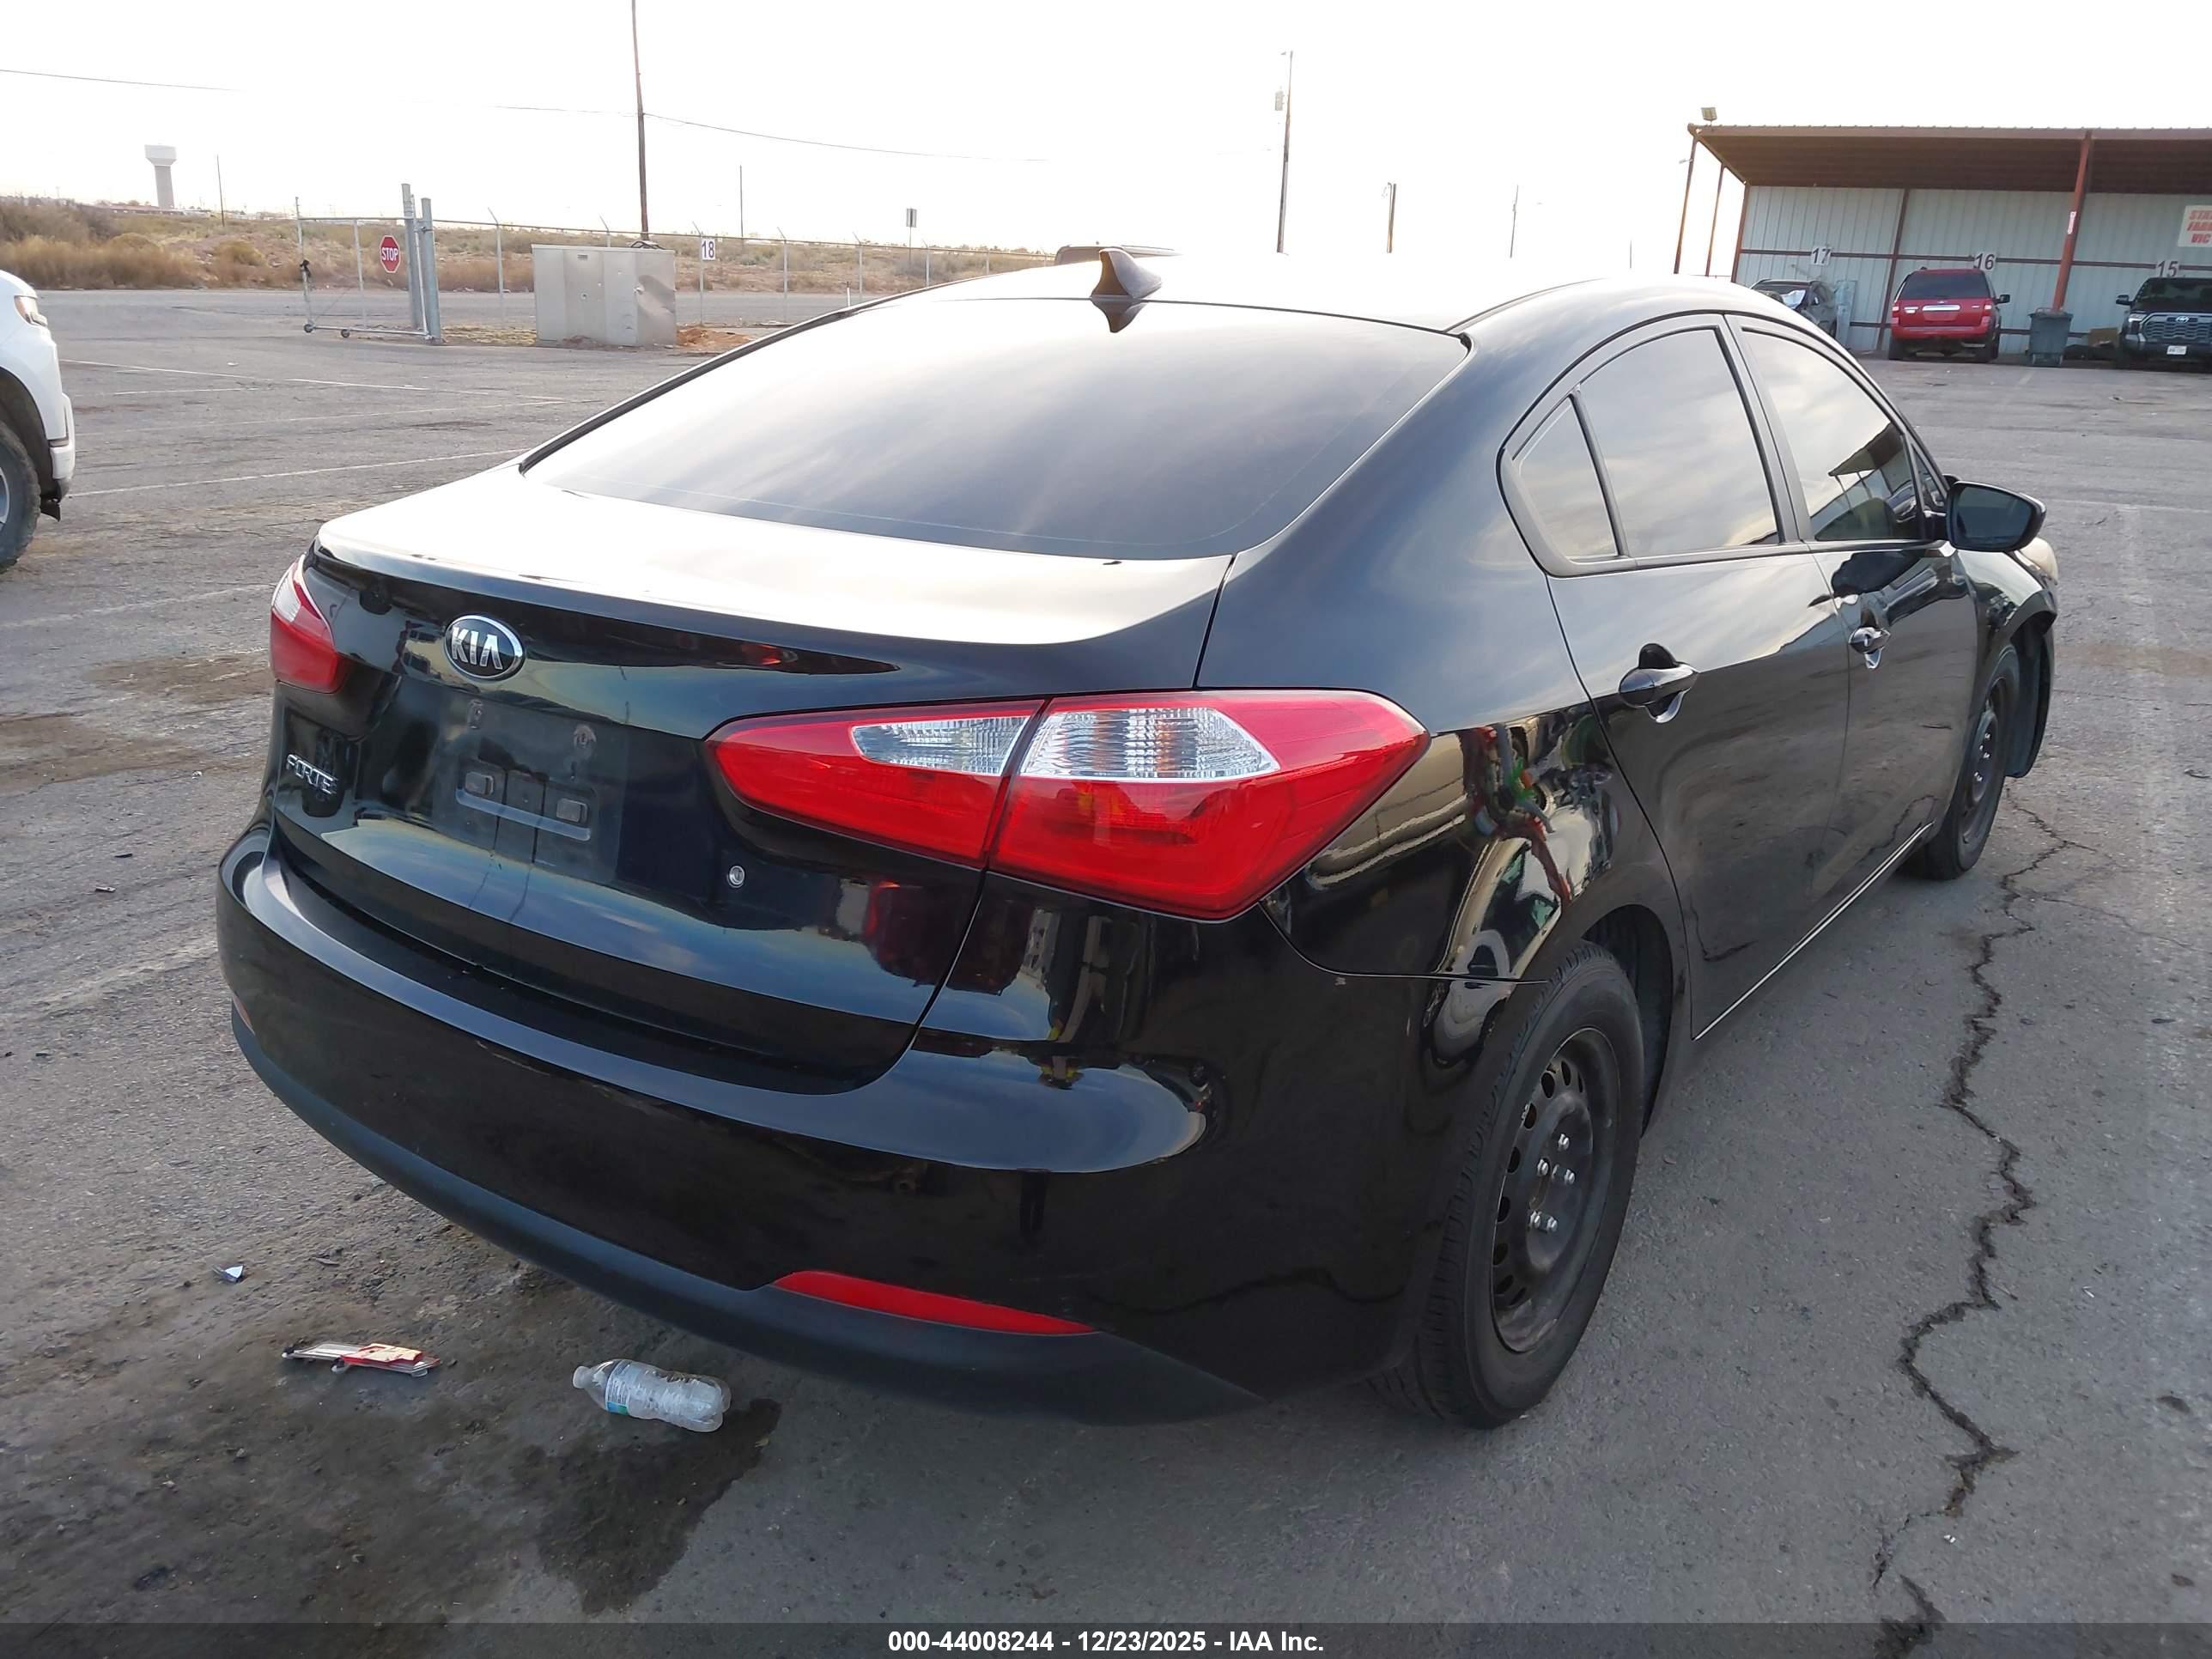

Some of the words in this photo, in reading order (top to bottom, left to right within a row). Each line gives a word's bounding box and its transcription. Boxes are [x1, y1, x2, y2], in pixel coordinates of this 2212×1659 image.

[381, 246, 398, 262] STOP
[702, 240, 714, 258] 18
[1812, 247, 1831, 264] 17
[1976, 252, 1995, 270] 16
[2157, 260, 2179, 277] 15
[451, 625, 503, 670] KIA
[285, 753, 338, 795] FORTE
